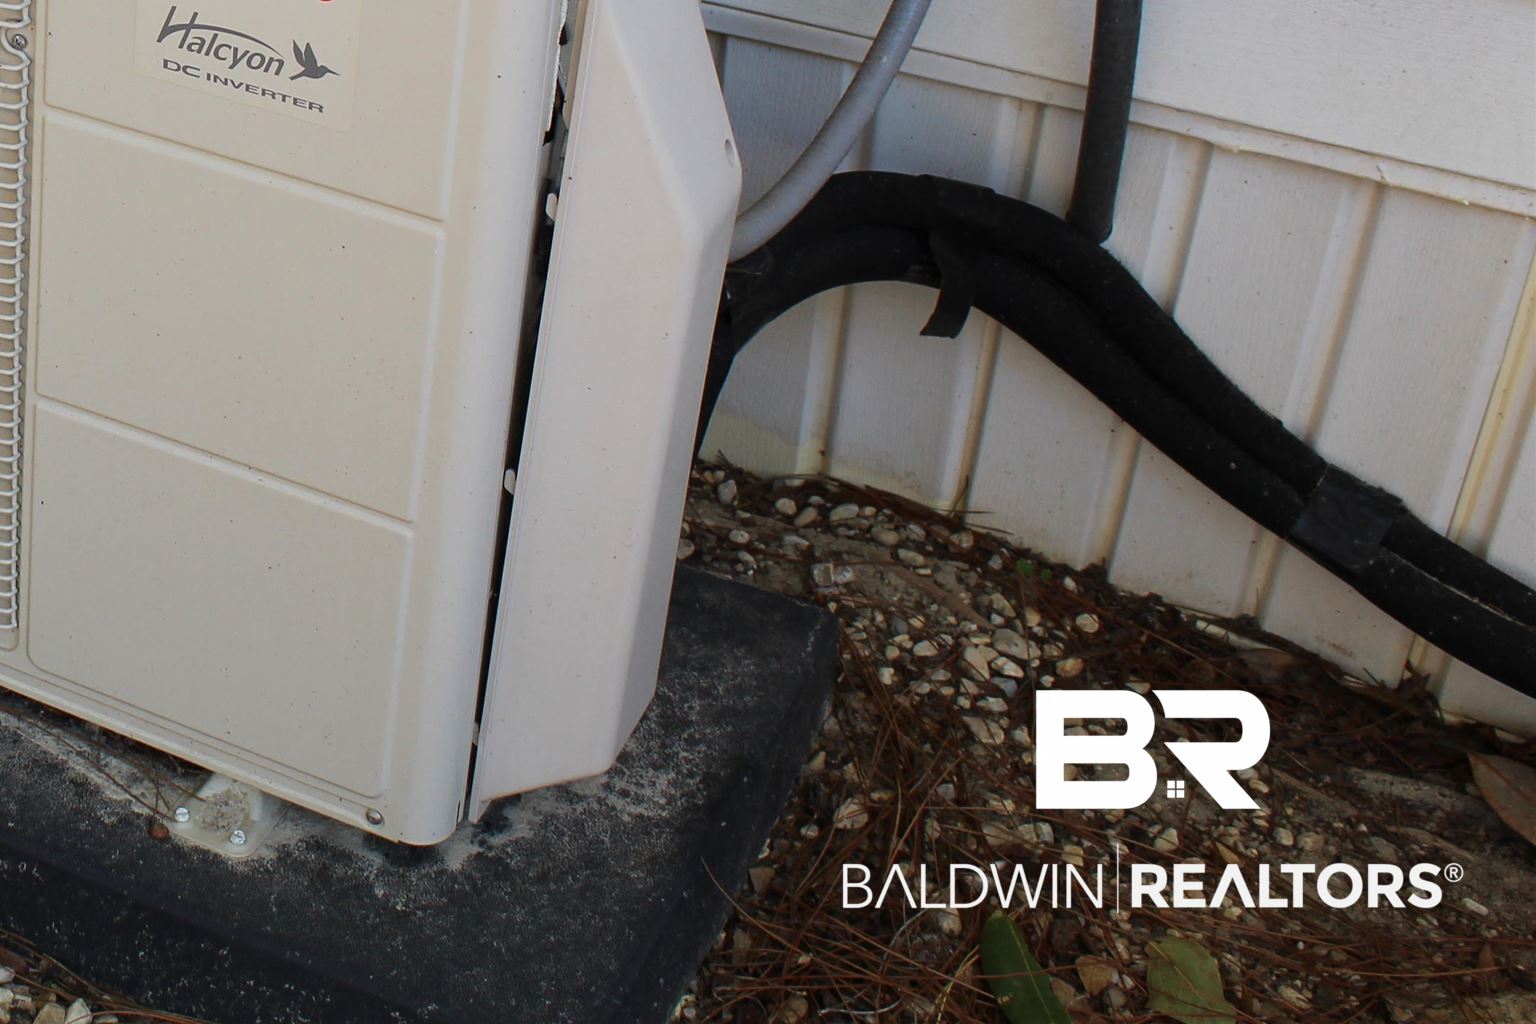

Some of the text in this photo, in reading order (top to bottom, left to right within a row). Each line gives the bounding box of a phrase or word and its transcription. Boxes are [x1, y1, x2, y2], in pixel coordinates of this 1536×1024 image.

[156, 5, 285, 77] Halcyon
[162, 58, 325, 114] DC INVERTER
